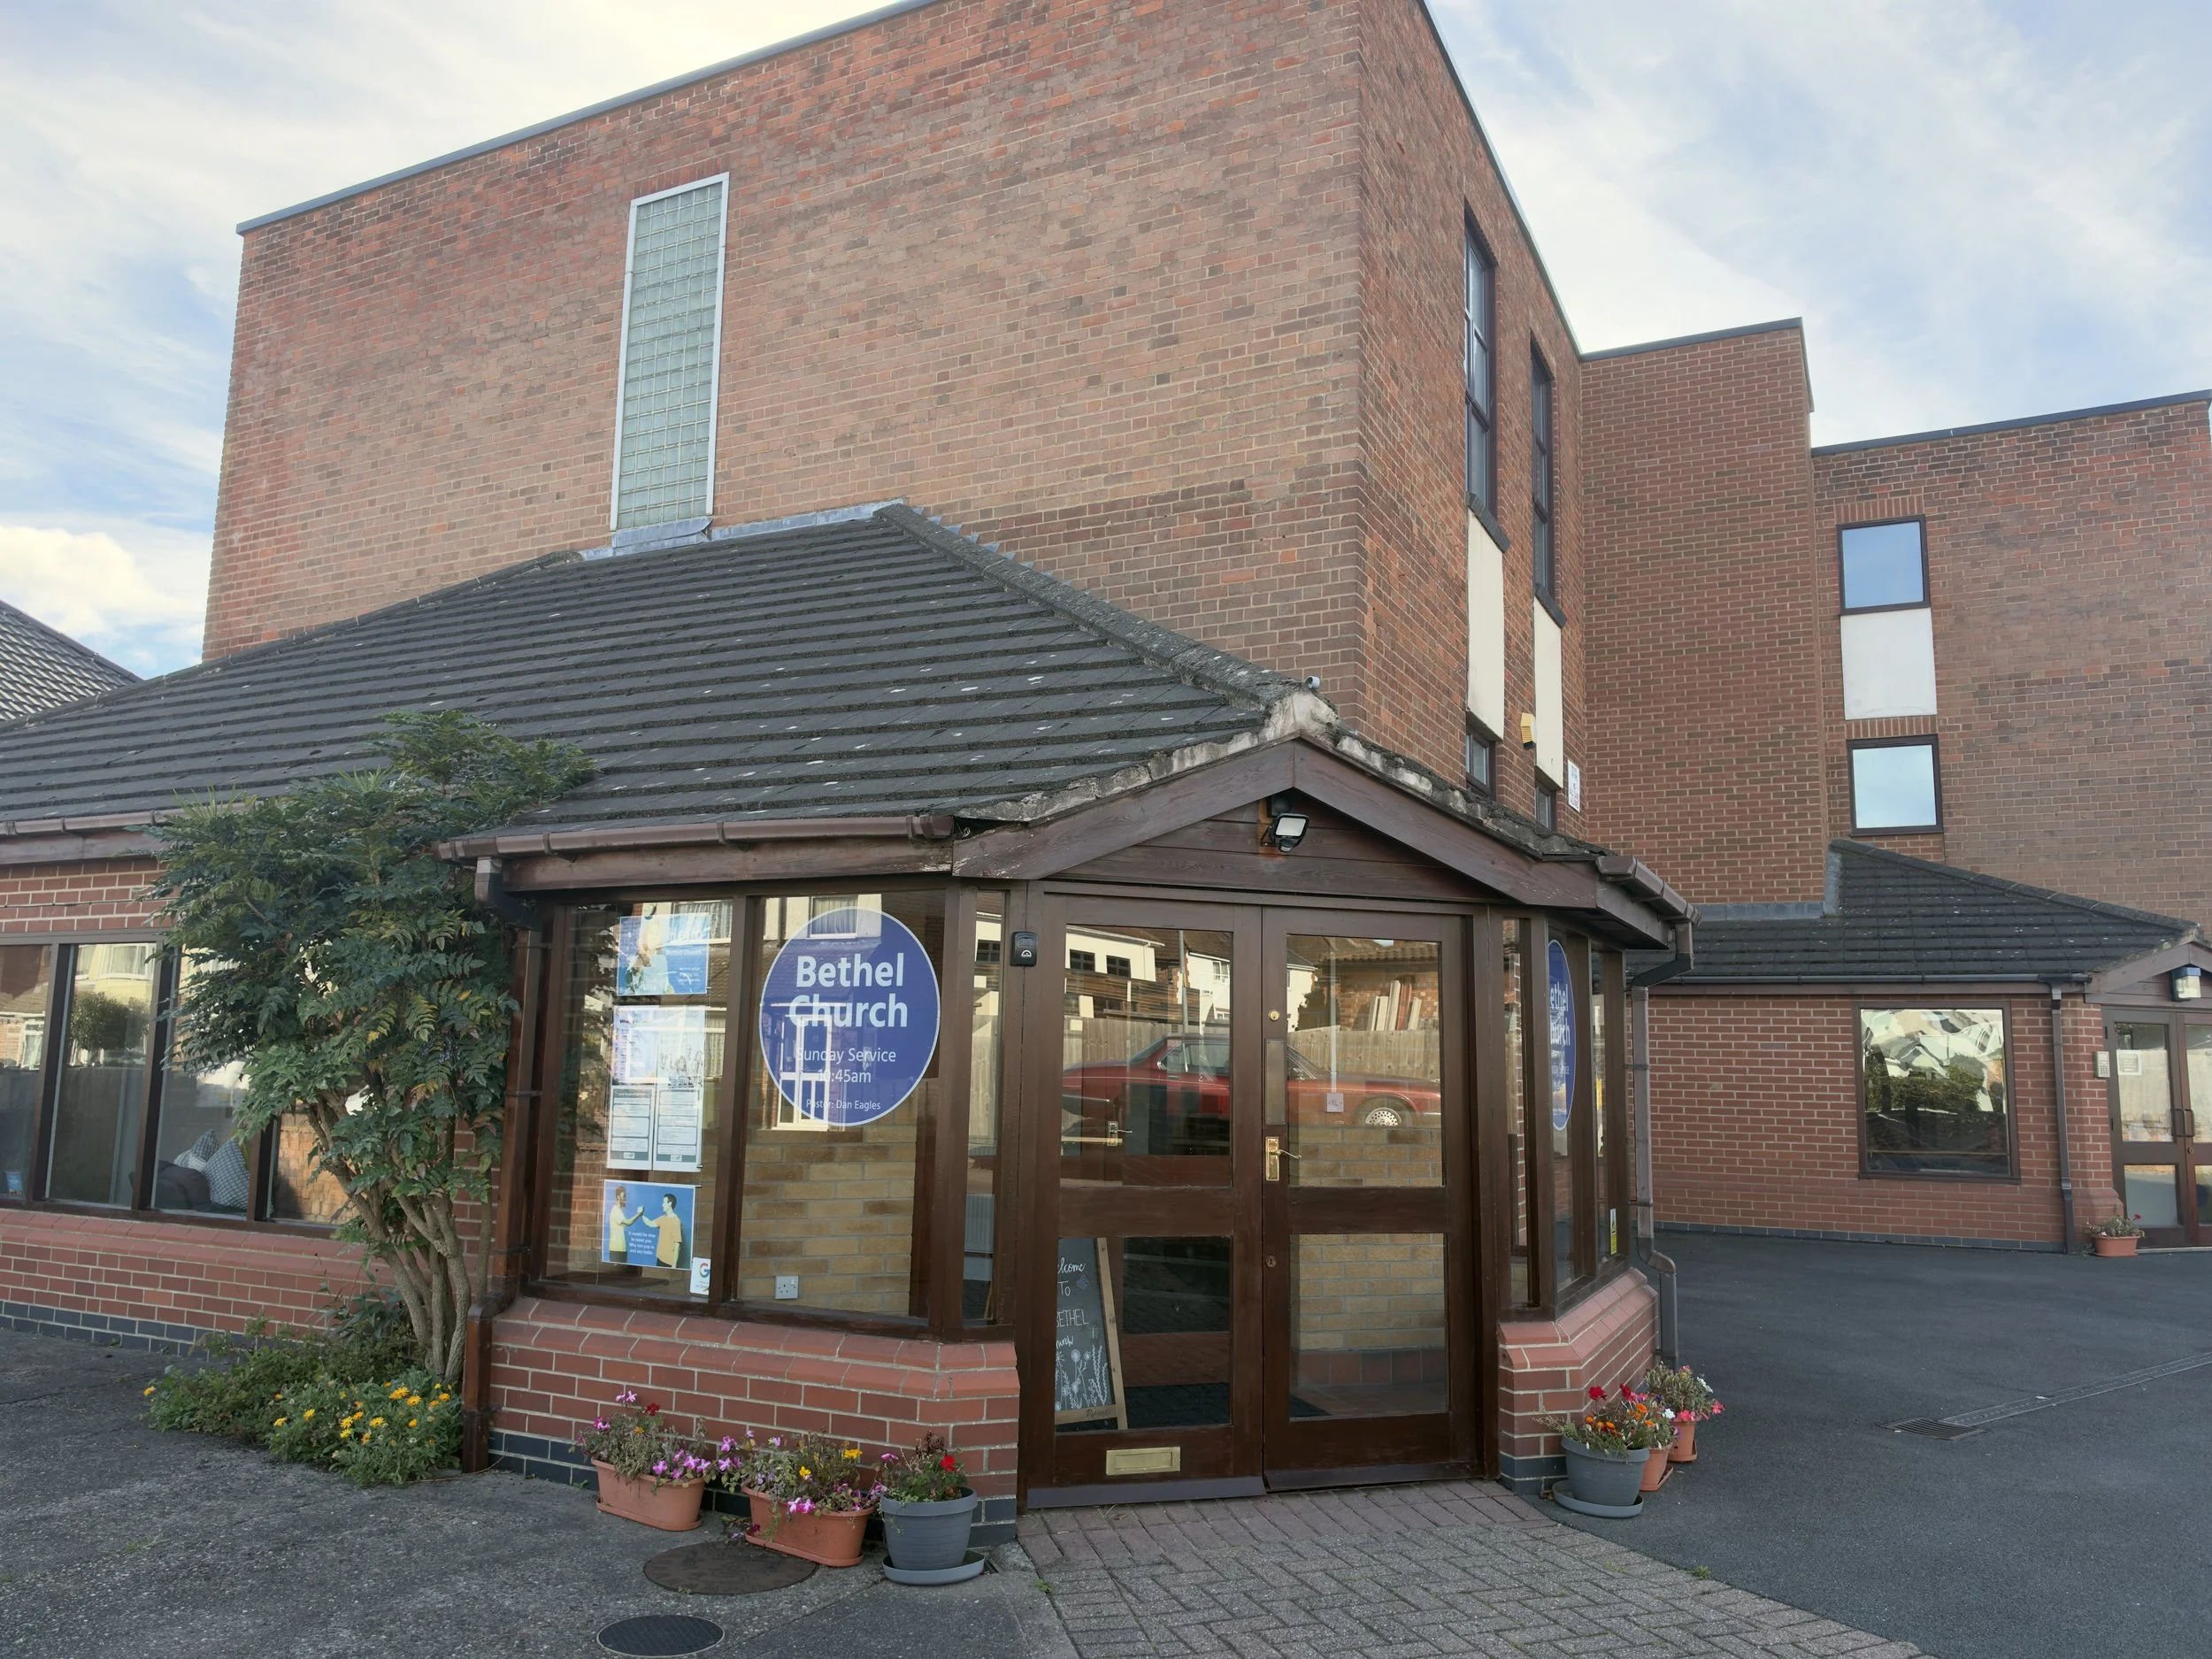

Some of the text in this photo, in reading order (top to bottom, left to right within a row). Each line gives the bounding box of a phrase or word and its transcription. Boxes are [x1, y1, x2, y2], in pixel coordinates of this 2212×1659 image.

[796, 952, 904, 987] Bethel
[1550, 981, 1569, 1011] ethel
[789, 993, 908, 1027] Church
[1550, 1015, 1571, 1046] hurch
[797, 1047, 896, 1064] Sunday Service
[836, 1100, 852, 1109] Dan
[854, 1100, 881, 1111] Eagles
[700, 1263, 710, 1278] G
[1057, 1256, 1086, 1273] lcome
[1057, 1280, 1071, 1296] To
